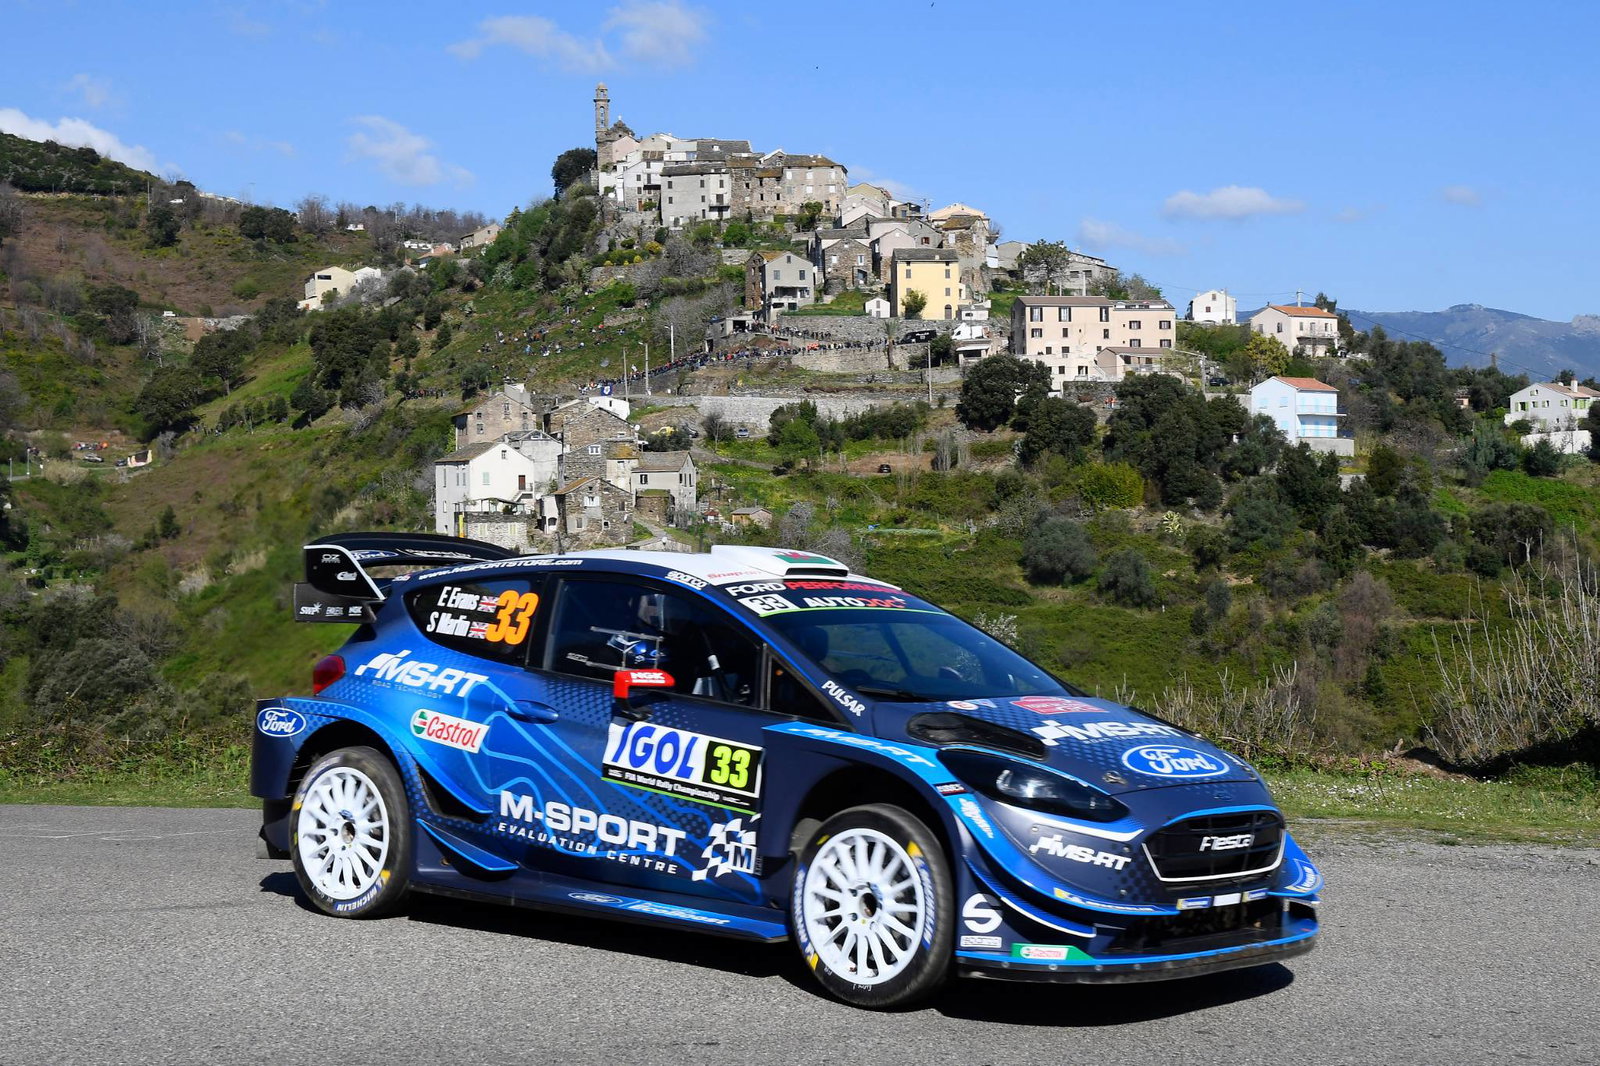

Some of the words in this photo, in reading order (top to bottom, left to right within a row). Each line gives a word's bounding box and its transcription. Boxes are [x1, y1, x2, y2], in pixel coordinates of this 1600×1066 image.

[437, 586, 452, 607] E
[449, 587, 480, 611] Evans
[725, 582, 787, 597] FORD
[484, 589, 539, 646] 33
[749, 597, 790, 612] 33
[426, 611, 439, 632] S
[630, 672, 665, 680] NGK
[821, 680, 866, 717] PULSAR
[261, 710, 298, 733] Ford
[426, 716, 481, 749] Castrol
[612, 724, 698, 780] IGOL
[710, 745, 751, 788] 33
[1139, 748, 1217, 774] Ford
[500, 790, 687, 857] M-SPORT
[498, 822, 598, 855] EVALUATION
[606, 850, 678, 874] CENTRE
[336, 884, 379, 912] MICHELIN
